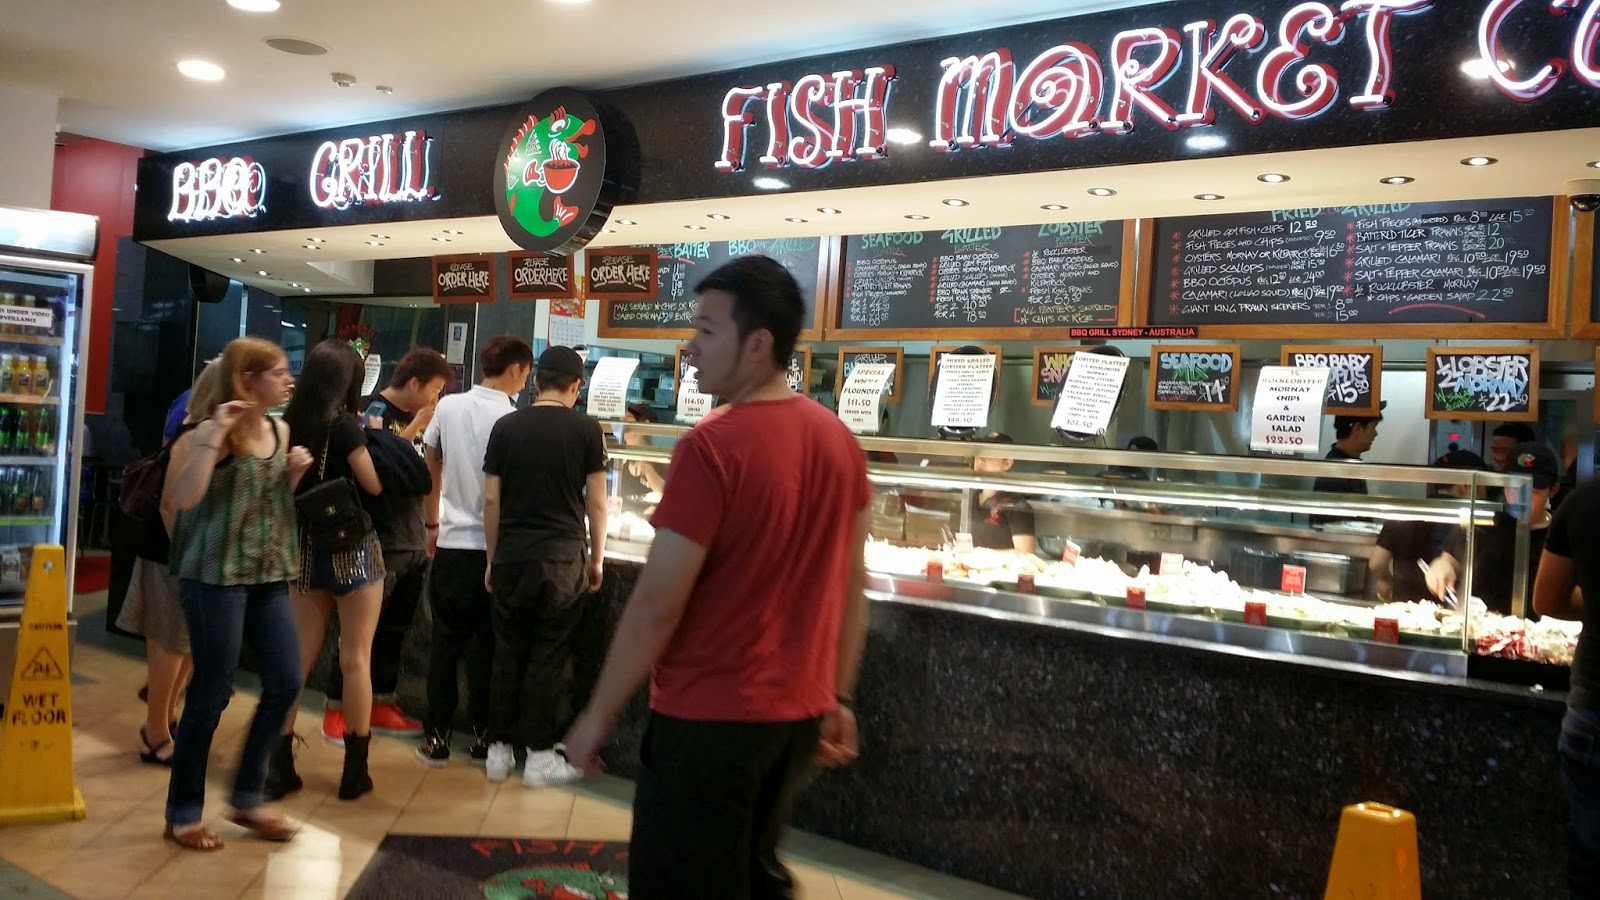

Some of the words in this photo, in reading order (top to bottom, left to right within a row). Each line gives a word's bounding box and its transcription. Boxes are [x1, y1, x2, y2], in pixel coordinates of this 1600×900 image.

[714, 63, 896, 172] FISH
[929, 0, 1434, 160] MARKET
[168, 155, 267, 222] BBQ
[309, 129, 441, 211] GRILL
[1271, 208, 1321, 223] FRIED
[1037, 220, 1107, 238] LOBSTER
[1356, 219, 1378, 230] FISH
[1381, 218, 1411, 229] PIECES
[1188, 227, 1221, 241] GRILLED
[1356, 231, 1398, 244] BATTERED
[1398, 229, 1427, 241] TIGER
[861, 231, 924, 250] SEAFOOD
[1186, 240, 1206, 253] FISH
[1210, 238, 1237, 251] PIECES
[1237, 240, 1253, 248] AND
[1254, 237, 1285, 250] CHIPS
[673, 242, 711, 260] BATTER
[1042, 246, 1088, 258] ROCKLOBSTER
[1356, 242, 1376, 254] SALT
[1387, 241, 1422, 253] PEPPER
[1424, 240, 1459, 252] PRAWNS
[523, 257, 550, 269] PLEASE
[602, 256, 635, 267] PLEASE
[939, 255, 955, 263] BBQ
[955, 253, 972, 262] BABY
[972, 252, 999, 261] OCTOPUS
[1031, 257, 1047, 267] BBQ
[1048, 255, 1064, 265] BABY
[1065, 255, 1094, 265] OCTOPUS
[1184, 252, 1223, 265] OYSTERS
[1226, 249, 1259, 262] MORNAY
[1259, 250, 1272, 260] OR
[1354, 255, 1392, 268] GRILLED
[1395, 253, 1441, 265] CALAMARI
[450, 263, 475, 273] PLEASE
[1030, 264, 1060, 274] CALAMARI
[1061, 263, 1082, 271] RINGS
[1183, 265, 1218, 278] GRILLED
[1219, 262, 1265, 275] SCALLOPS
[1354, 269, 1377, 281] SALT
[1384, 267, 1420, 280] PEPPER
[1420, 267, 1464, 279] CALAMARI
[437, 271, 468, 291] ORDER
[468, 270, 490, 289] HERE
[590, 266, 628, 285] ORDER
[627, 264, 650, 284] HERE
[1030, 272, 1056, 281] OYSTERS
[1059, 270, 1086, 281] MORNAY
[1182, 278, 1208, 290] BBQ
[1209, 275, 1253, 288] OCTOPUS
[1368, 280, 1435, 294] ROCKLOBSTER
[1442, 279, 1480, 291] MORNAY
[1029, 286, 1050, 297] FRESH
[1051, 285, 1068, 295] KING
[1181, 289, 1228, 301] CALAMARI
[1376, 293, 1401, 303] CHIPS
[1407, 292, 1443, 302] GARDEN
[1446, 291, 1476, 301] SALAD
[1027, 294, 1044, 306] FOR
[1044, 294, 1053, 305] 2
[6, 308, 29, 316] UNDER
[31, 310, 51, 318] VIDEO
[1020, 304, 1037, 316] ALL
[1181, 303, 1211, 314] GIANT
[1213, 303, 1238, 314] KING
[1239, 301, 1269, 313] PRAWN
[1270, 301, 1311, 312] SKEWERS
[616, 312, 635, 321] SALAD
[1032, 314, 1056, 325] CHIPS
[1071, 329, 1088, 337] BBQ
[1089, 329, 1111, 337] GRILL
[1112, 328, 1144, 337] SYDNEY
[1148, 328, 1195, 337] AUSTRALIA
[1101, 359, 1127, 367] PLATTER
[1160, 352, 1232, 373] SEAFOOD
[1294, 352, 1328, 369] BBQ
[1328, 352, 1372, 371] BABY
[856, 368, 886, 376] SPECIAL
[1449, 354, 1530, 382] LOBSTER
[1171, 366, 1209, 386] MIX
[843, 387, 880, 396] FLOUNDER
[1268, 385, 1312, 394] MORNAY
[1453, 374, 1526, 401] MORNAY
[684, 397, 706, 405] $14.50
[846, 397, 872, 407] $13.50
[1276, 394, 1301, 403] CHIPS
[1283, 404, 1291, 412] &
[1265, 413, 1306, 424] GARDEN
[1271, 424, 1303, 434] SALAD
[1265, 434, 1304, 446] $22.50
[28, 621, 63, 632] CAUTION
[22, 691, 60, 709] WET
[11, 708, 67, 727] FLOOR
